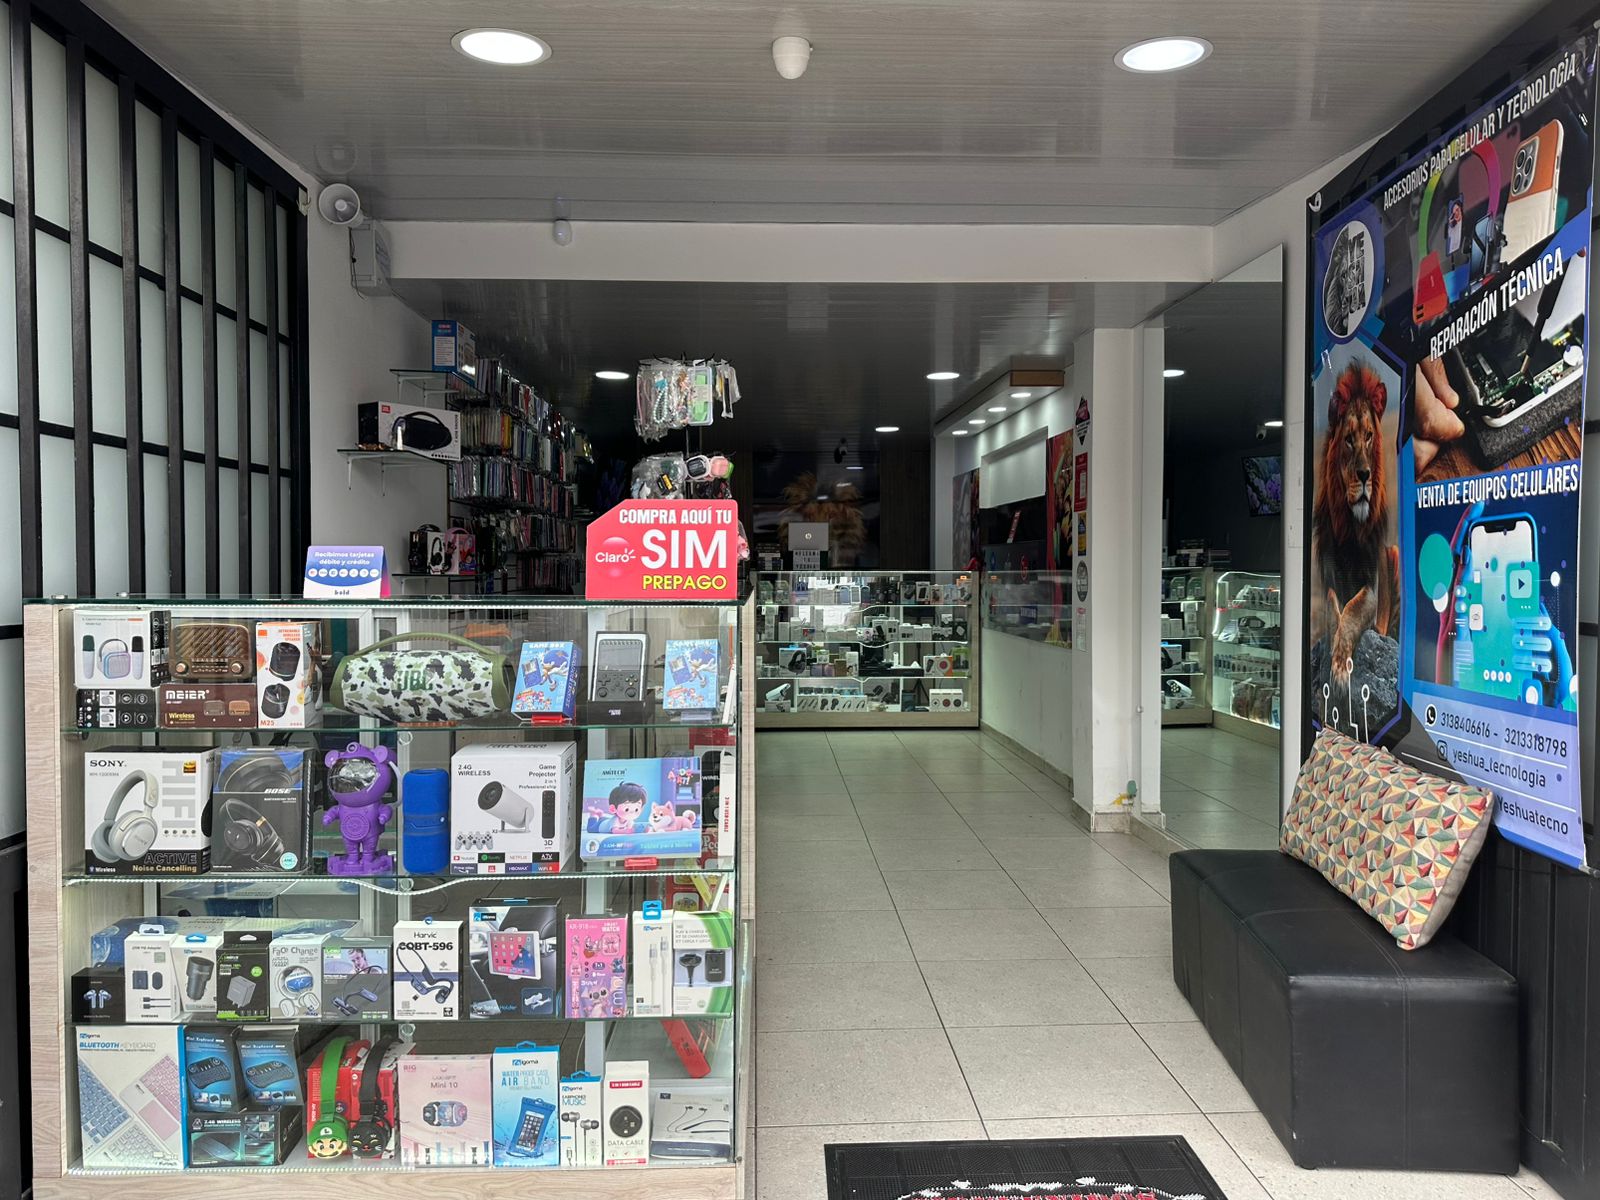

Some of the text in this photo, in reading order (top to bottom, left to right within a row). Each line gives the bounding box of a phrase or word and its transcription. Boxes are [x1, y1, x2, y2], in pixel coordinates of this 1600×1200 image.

[1384, 52, 1576, 210] ACCESORIOS PARA CELULAR Y TECNOLOGÍA
[1430, 247, 1563, 361] REPARACIÓN TÉCNICA
[1417, 464, 1578, 510] VENTA DE EQUIPOS CELULARES
[619, 505, 732, 524] COMPRA AQUÍ TU
[595, 552, 629, 563] Claro
[641, 529, 727, 569] SIM
[643, 575, 727, 590] PREPAGO
[397, 670, 434, 690] JBL
[1441, 711, 1490, 739] 3138406616
[1504, 729, 1567, 758] 3213318798
[1452, 748, 1546, 788] yeshua_tecnologia
[1497, 794, 1569, 836] Yeshuatecno
[144, 853, 198, 864] ACTIVE
[156, 864, 198, 874] Cancelling
[291, 947, 318, 955] Change
[502, 1076, 549, 1086] AIR BAND
